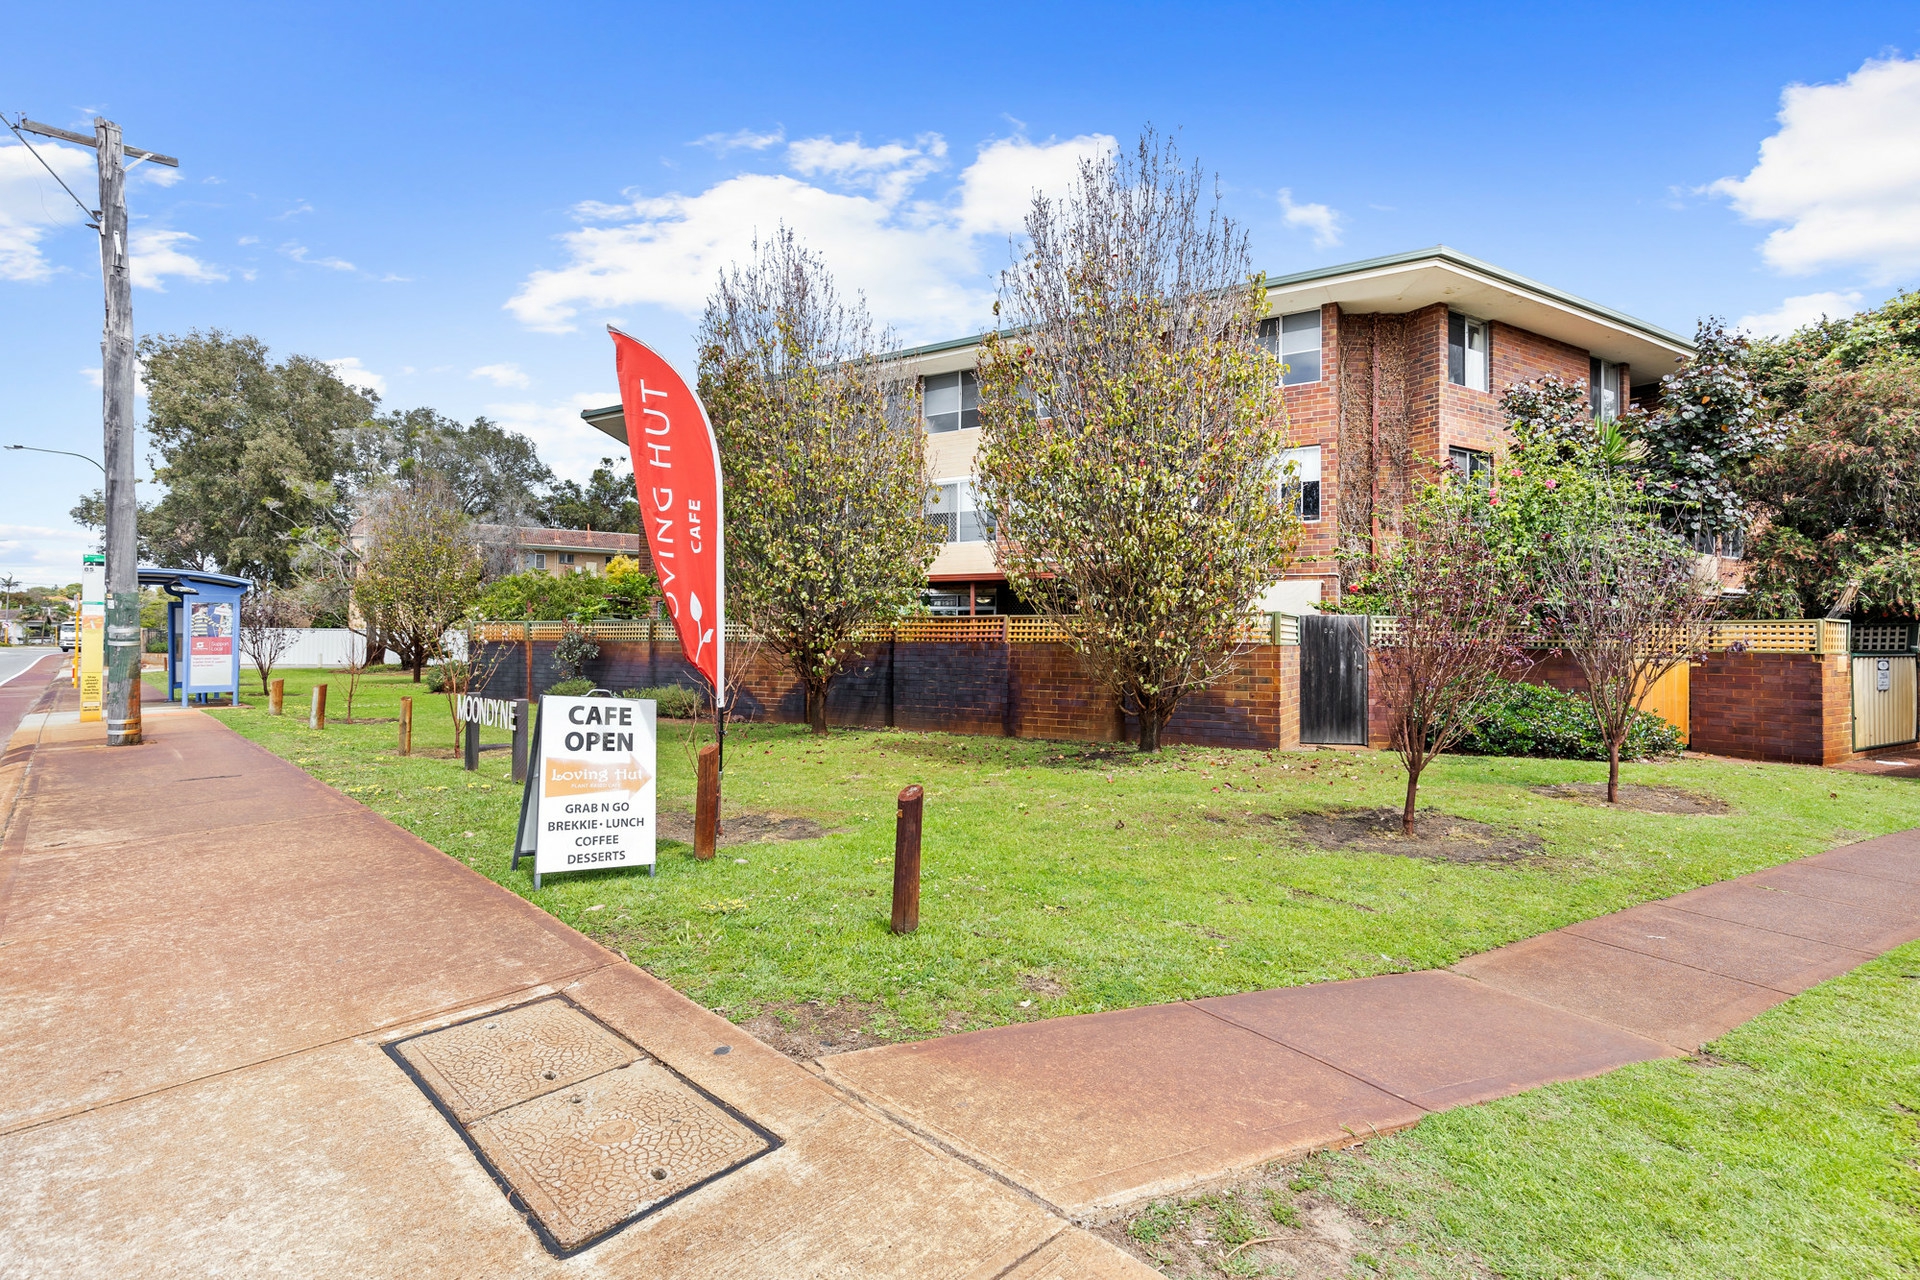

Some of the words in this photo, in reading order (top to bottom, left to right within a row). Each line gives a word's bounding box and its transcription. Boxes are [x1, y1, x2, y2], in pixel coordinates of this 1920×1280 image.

[640, 378, 672, 469] HUT
[688, 499, 702, 554] CAFE
[653, 486, 679, 619] OVING
[457, 694, 518, 731] MOONDYNE
[568, 705, 632, 726] CAFE
[564, 731, 634, 752] OPEN
[551, 768, 609, 782] Loving
[614, 768, 643, 781] Hut
[565, 803, 598, 814] GRAB
[601, 803, 610, 812] N
[612, 802, 630, 812] GO
[547, 819, 598, 832] BREKKIE
[606, 817, 645, 829] LUNCH
[575, 834, 620, 847] COFFEE
[567, 850, 626, 865] DESSERTS
